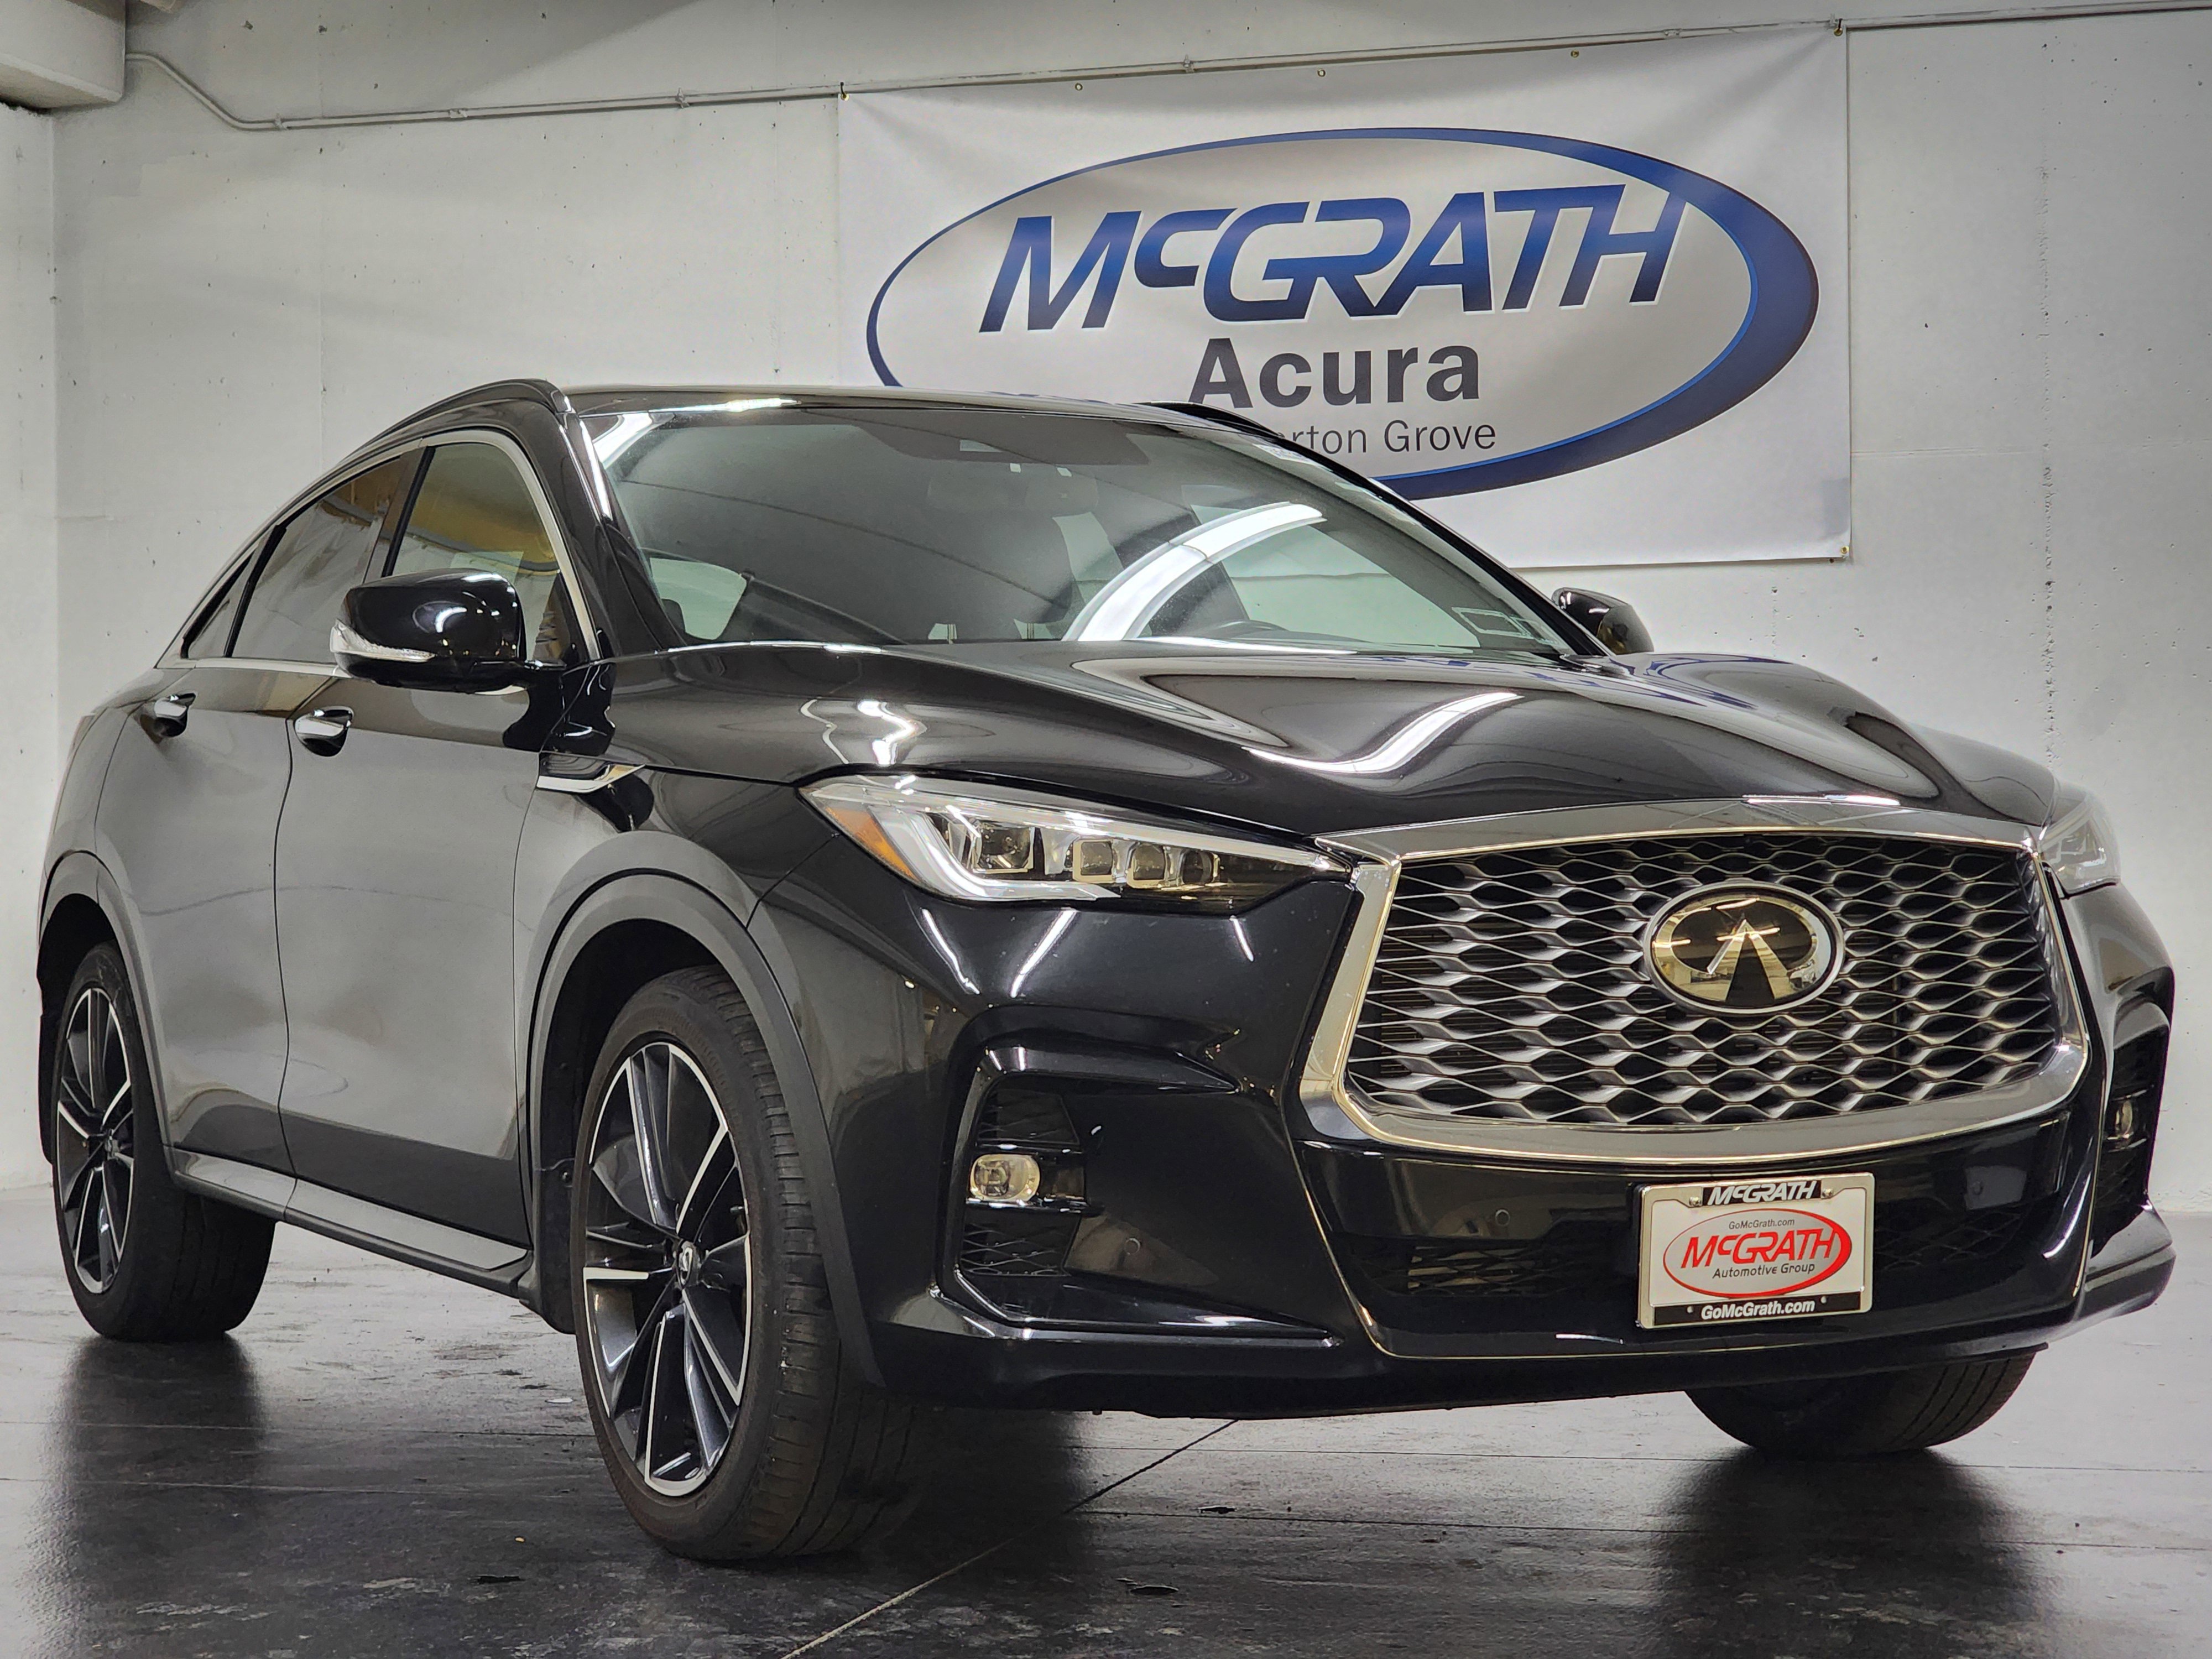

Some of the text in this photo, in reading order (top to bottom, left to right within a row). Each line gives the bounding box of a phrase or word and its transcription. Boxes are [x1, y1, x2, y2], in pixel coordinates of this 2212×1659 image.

[1189, 338, 1480, 409] Acura
[1281, 425, 1368, 455] rton
[1384, 420, 1496, 453] Grove
[1729, 1218, 1796, 1230] GoMcGrath.com
[1712, 1263, 1815, 1279] Automotive Group
[1701, 1300, 1815, 1320] GoMcGrath.com
